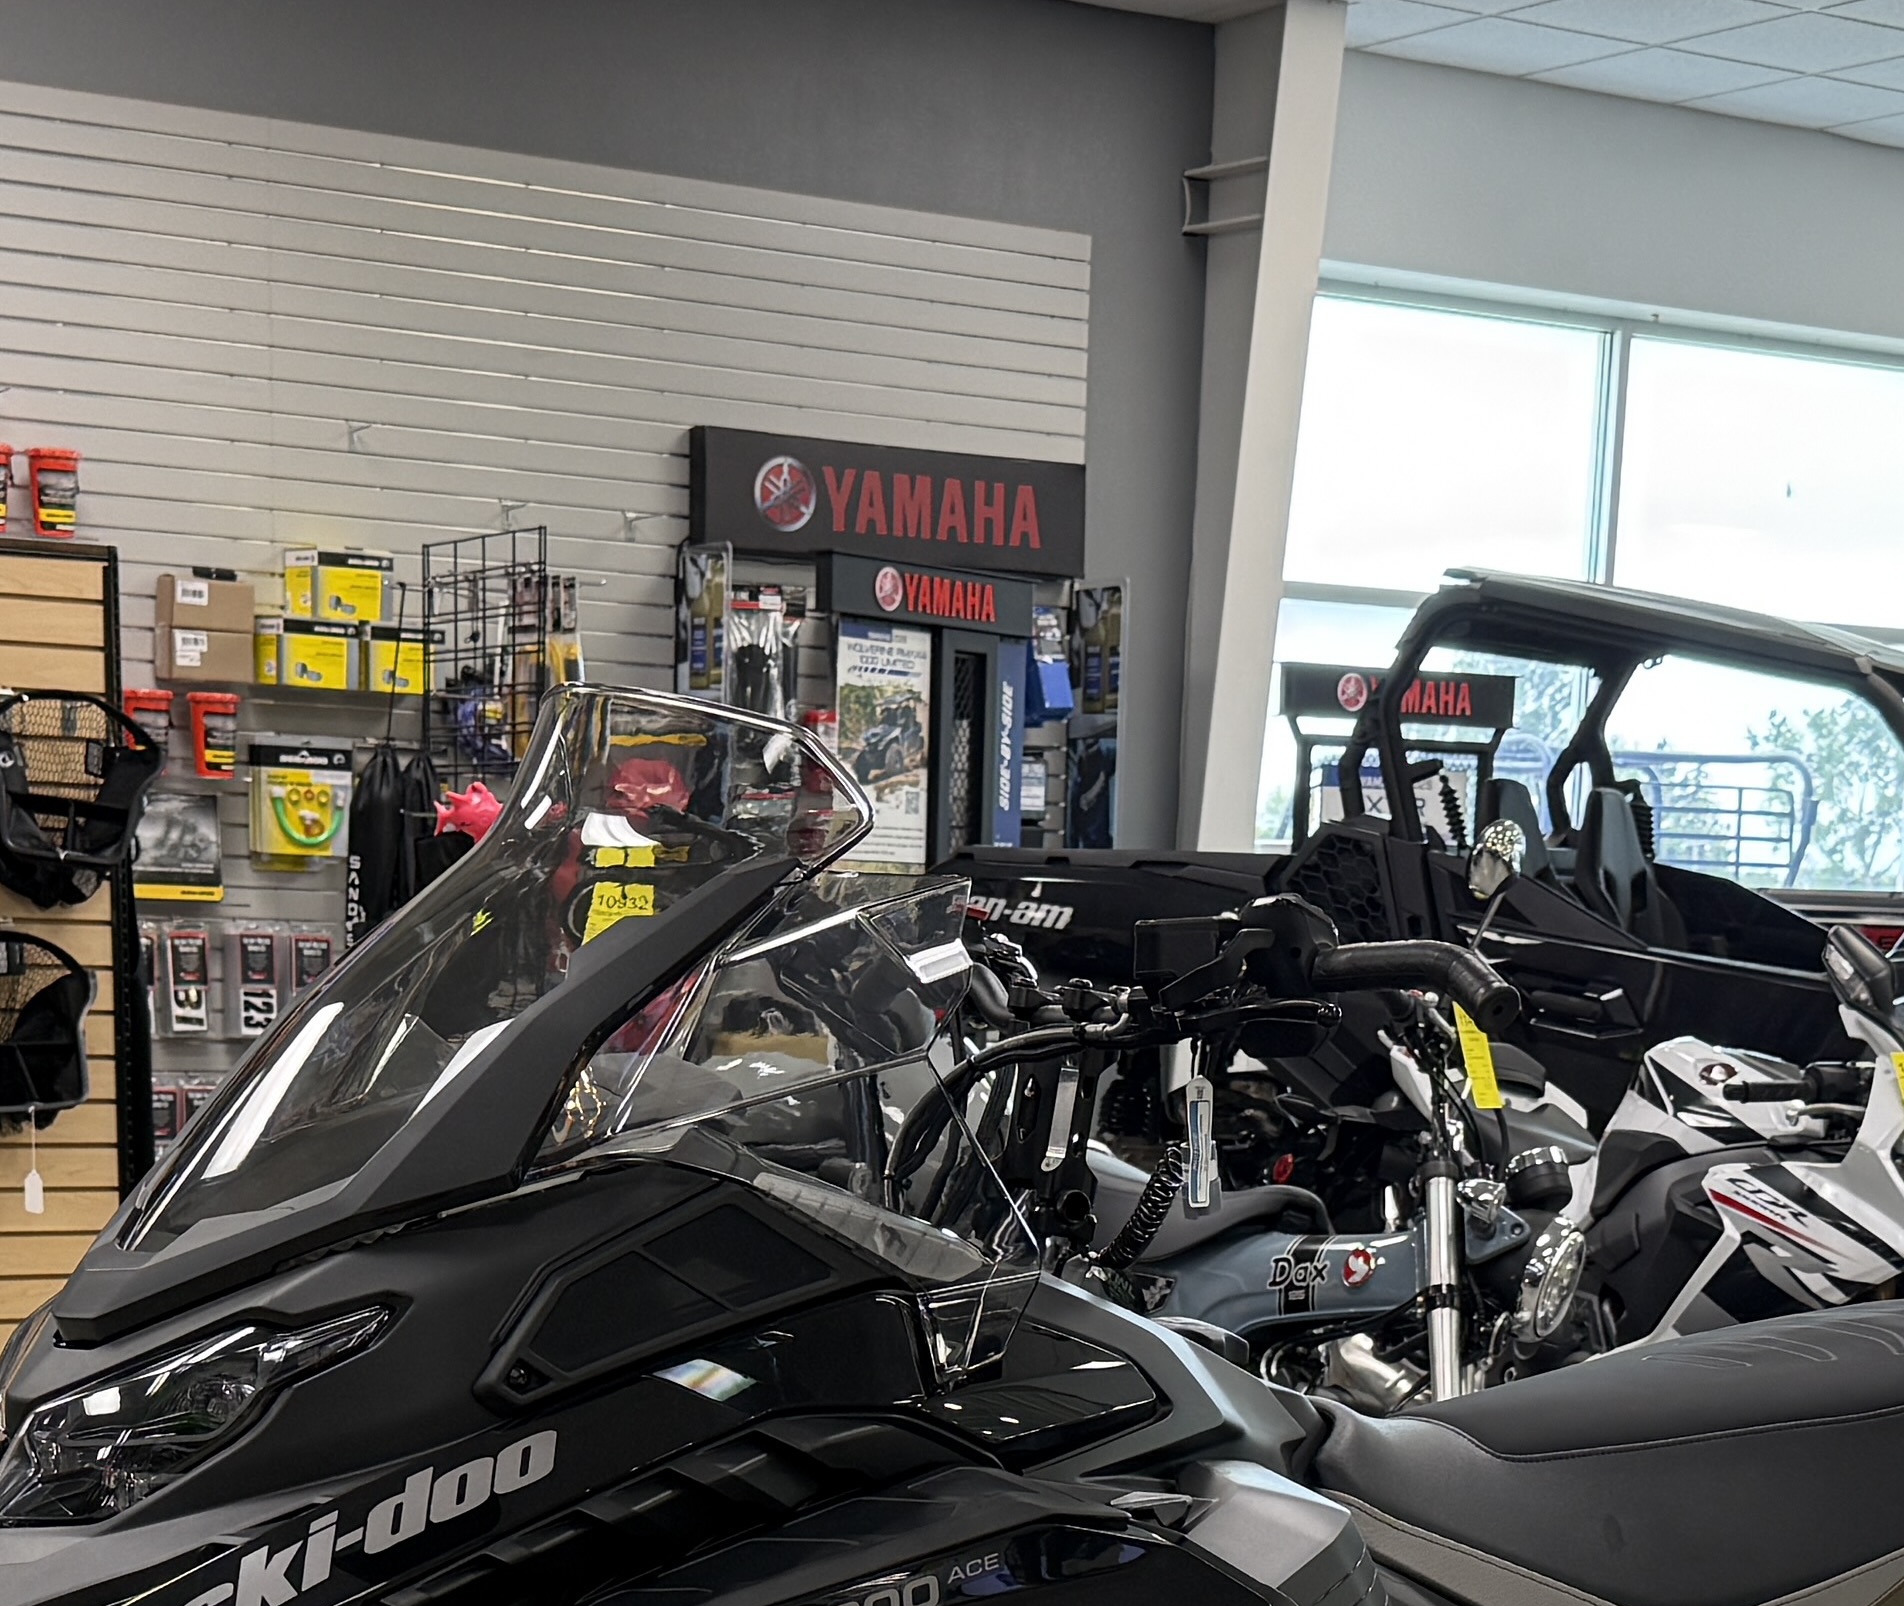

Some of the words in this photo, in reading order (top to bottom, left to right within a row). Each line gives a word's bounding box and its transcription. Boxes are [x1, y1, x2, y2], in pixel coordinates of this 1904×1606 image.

[822, 466, 1041, 549] YAMAHA
[904, 573, 995, 623] YAMAHA
[999, 681, 1014, 811] SIDE-BY-SIDE
[1267, 1255, 1331, 1289] Dax
[947, 1553, 1000, 1584] ACE
